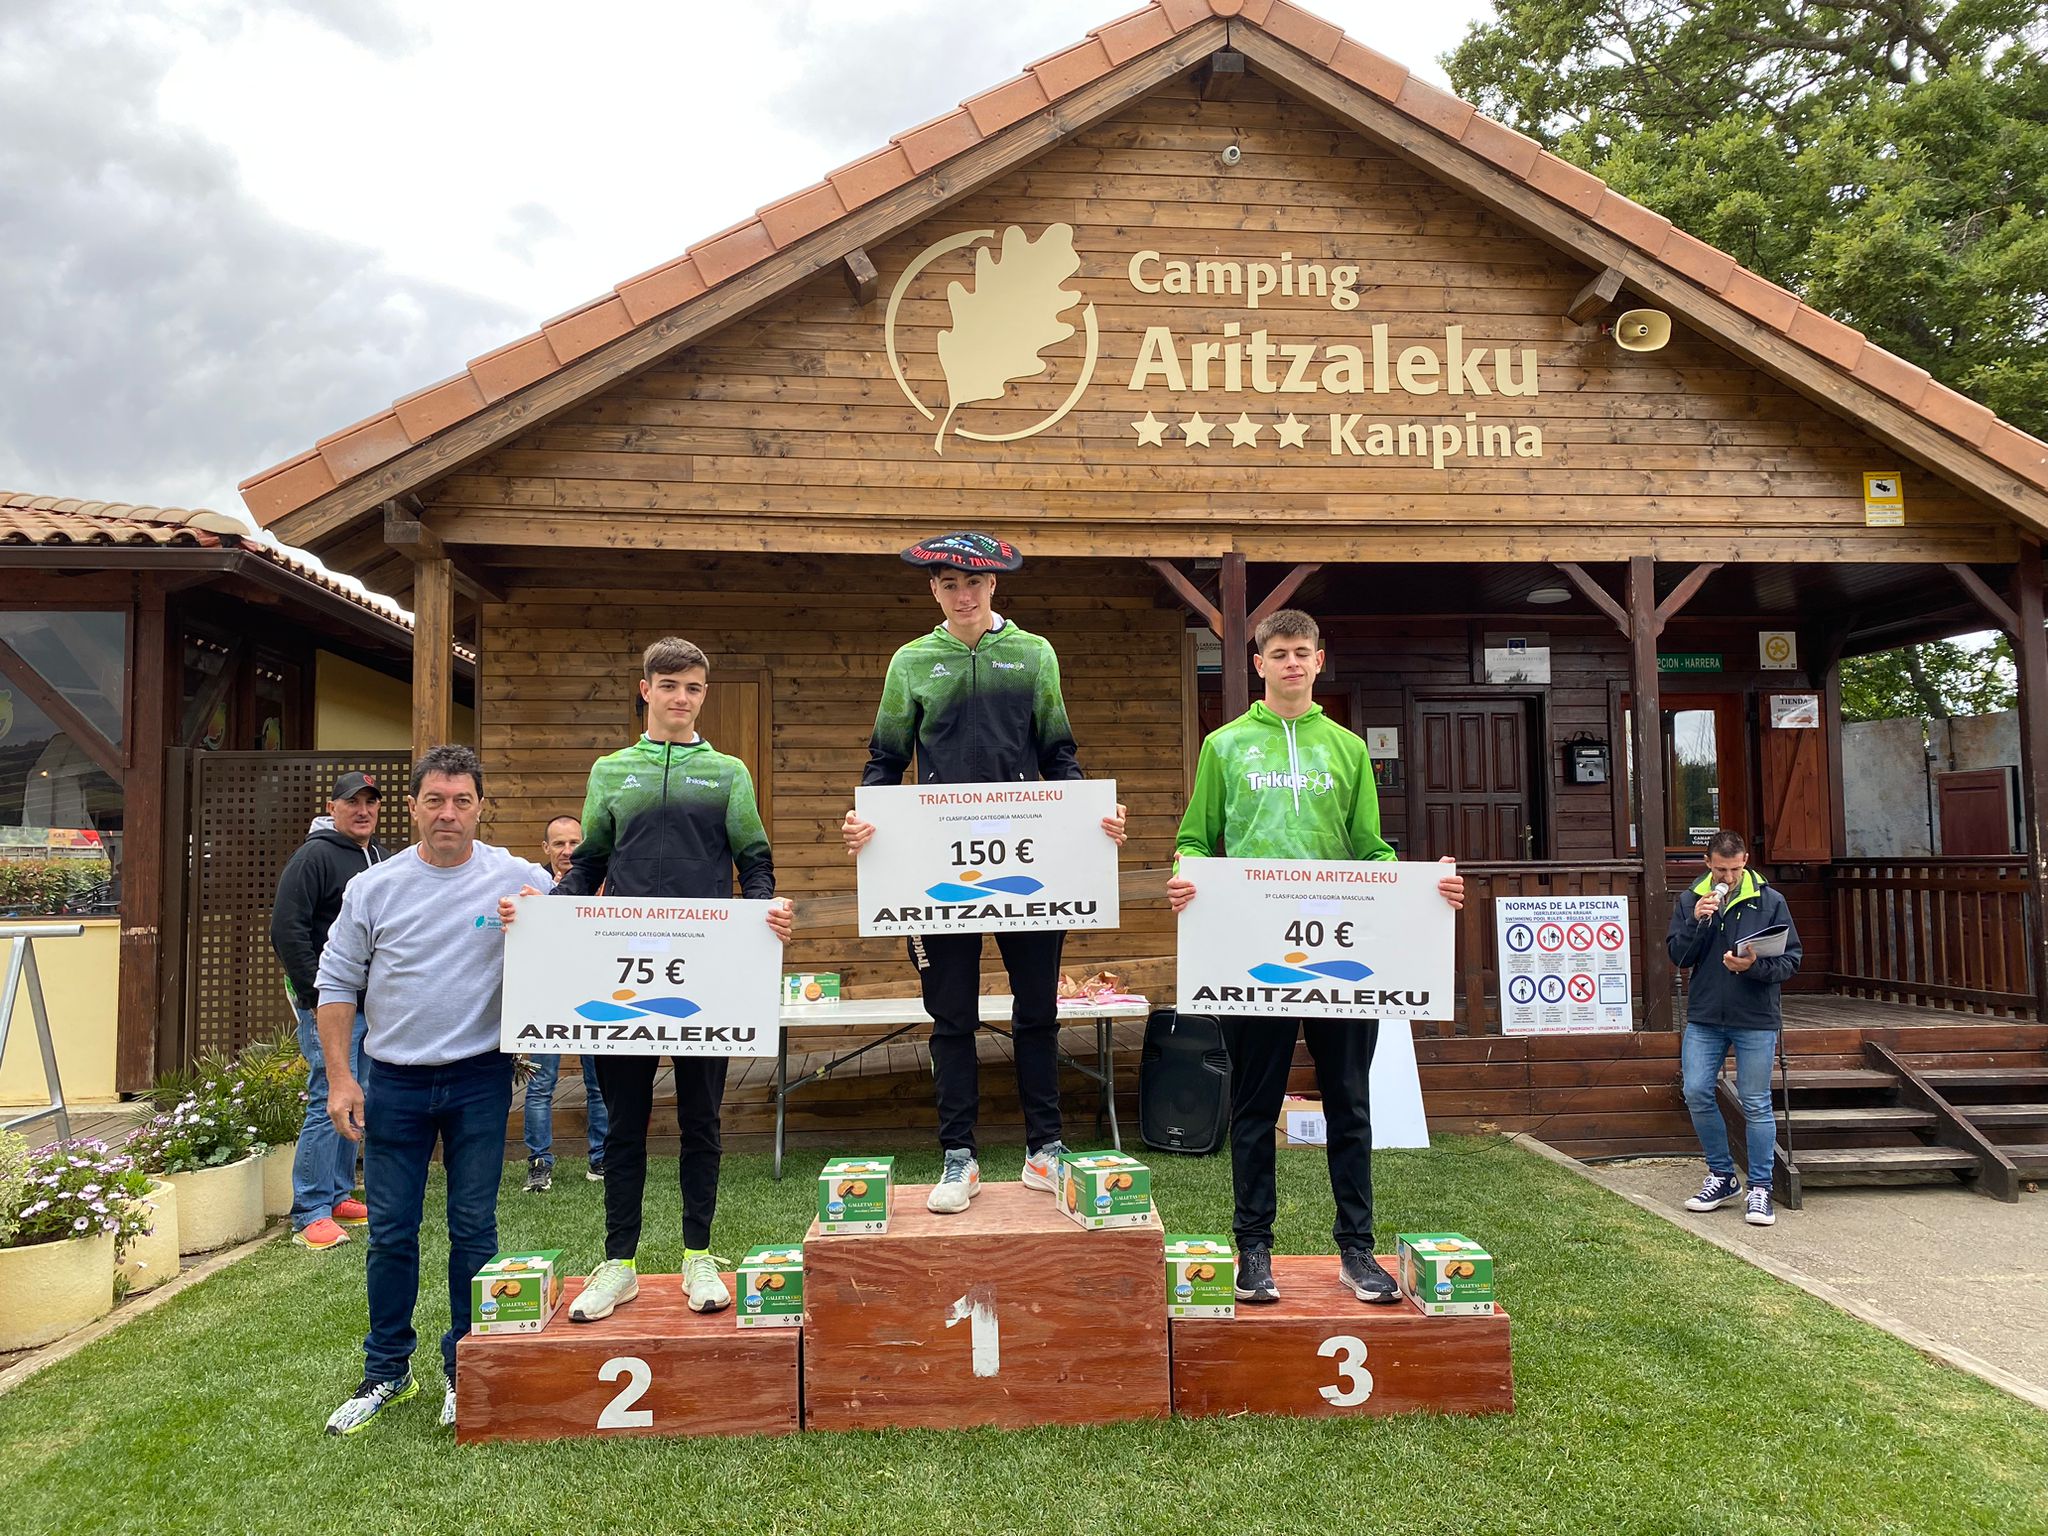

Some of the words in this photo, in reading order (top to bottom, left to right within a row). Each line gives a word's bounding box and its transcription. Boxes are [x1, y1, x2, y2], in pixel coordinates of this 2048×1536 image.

[1128, 251, 1360, 311] Camping
[1127, 323, 1539, 397] Aritzaleku
[1329, 412, 1543, 469] Kanpina
[1685, 658, 1720, 669] HARRERA
[919, 793, 982, 805] TRIATLON
[986, 790, 1063, 803] ARITZALEKU
[951, 840, 1006, 866] 150
[1015, 838, 1034, 863] €
[1245, 869, 1311, 881] TRIATLON
[1315, 871, 1398, 884] ARITZALEKU
[575, 906, 642, 919] TRIATLON
[646, 908, 729, 921] ARITZALEKU
[872, 900, 1097, 923] ARITZALEKU
[1505, 902, 1547, 910] NORMAS
[1550, 902, 1562, 910] DE
[1579, 901, 1619, 910] PISCINA
[873, 922, 966, 931] TRIATLON
[998, 918, 1098, 927] TRIATLOIA
[1284, 920, 1324, 948] 40
[1334, 921, 1354, 948] €
[616, 957, 654, 984] 75
[665, 959, 685, 985] €
[1192, 986, 1430, 1006] ARITZALEKU
[1323, 1007, 1430, 1016] TRIATLOIA
[516, 1024, 756, 1042] ARITZALEKU
[516, 1042, 615, 1050] TRIATLON
[649, 1044, 756, 1052] TRIATLOIA
[945, 1295, 999, 1377] 1
[1317, 1335, 1374, 1407] 3
[597, 1356, 654, 1429] 2
